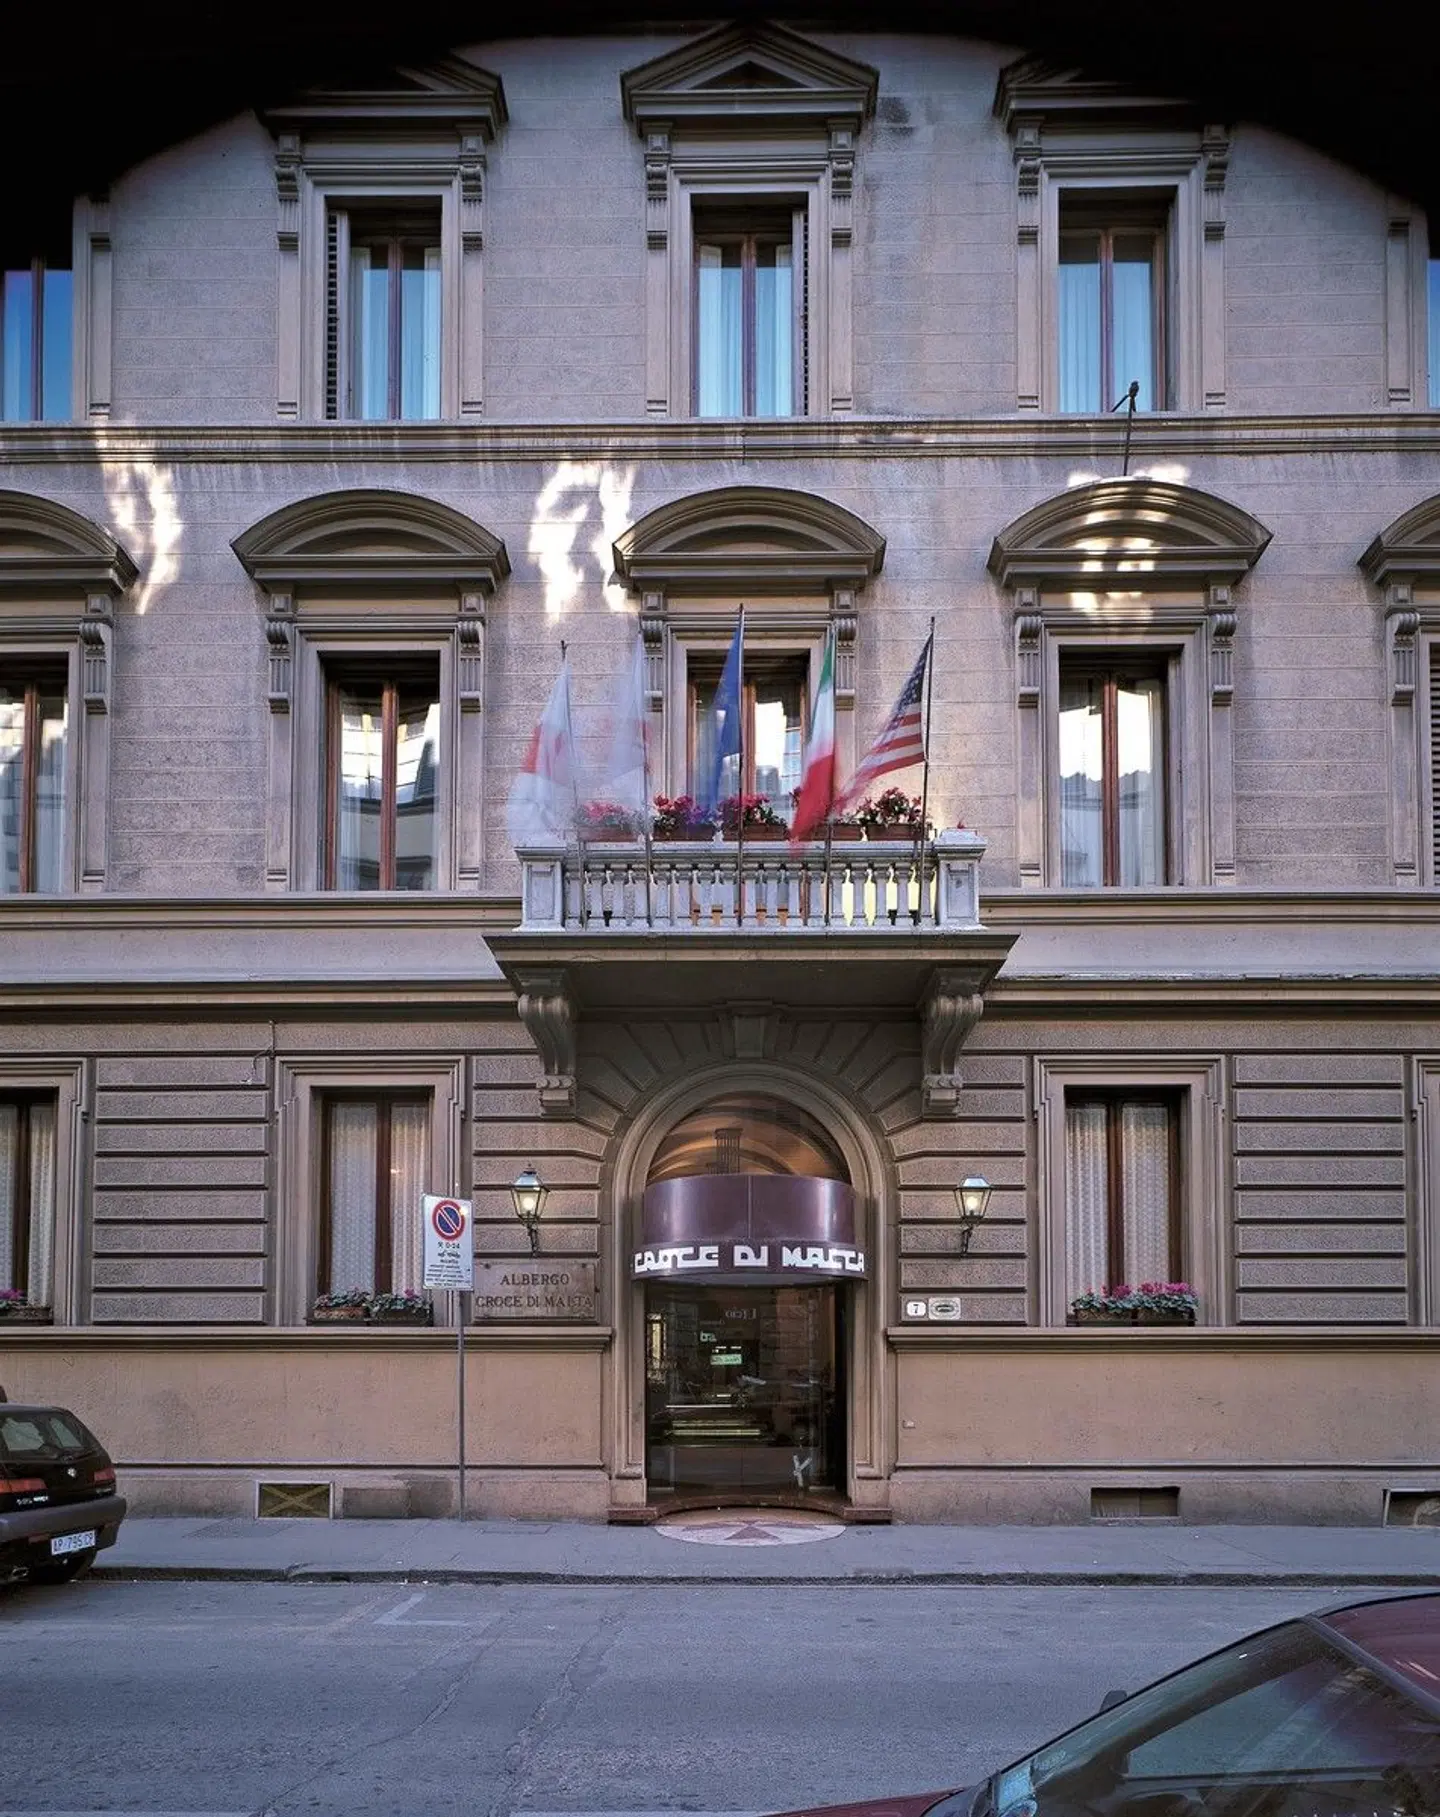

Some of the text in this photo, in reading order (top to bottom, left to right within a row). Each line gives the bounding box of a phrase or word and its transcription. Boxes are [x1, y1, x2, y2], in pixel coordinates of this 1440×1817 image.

[733, 1245, 768, 1267] DI
[500, 1273, 569, 1286] ALBERGO
[475, 1295, 593, 1308] CROCE DI MALTA
[913, 1303, 920, 1314] 7
